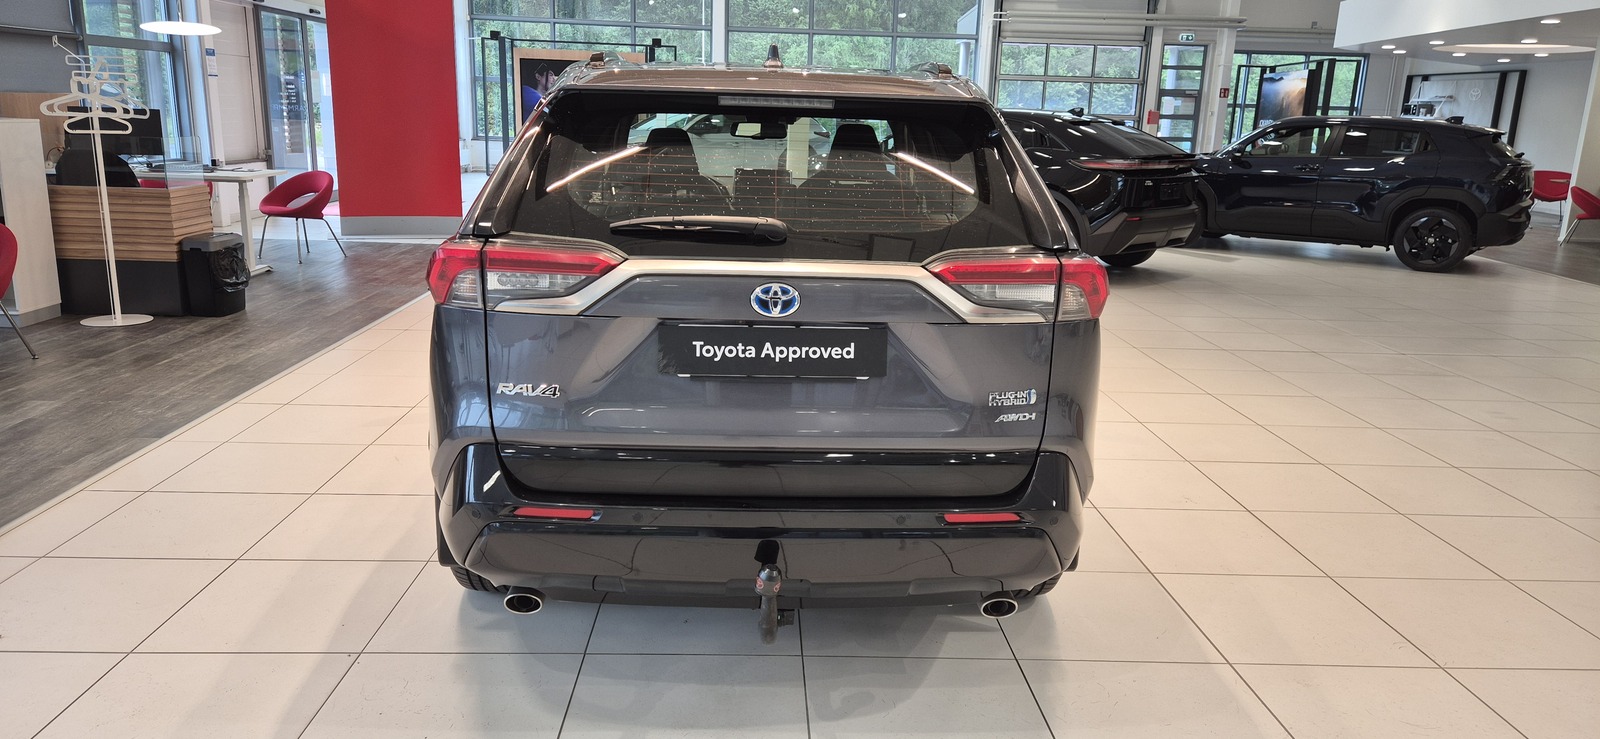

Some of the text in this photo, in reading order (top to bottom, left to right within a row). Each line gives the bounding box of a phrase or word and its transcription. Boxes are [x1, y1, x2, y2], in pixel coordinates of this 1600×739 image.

[692, 341, 855, 362] Toyota Approved
[496, 382, 560, 398] RAV4
[989, 391, 1027, 400] PLUG-IN
[989, 398, 1027, 406] HYBRID
